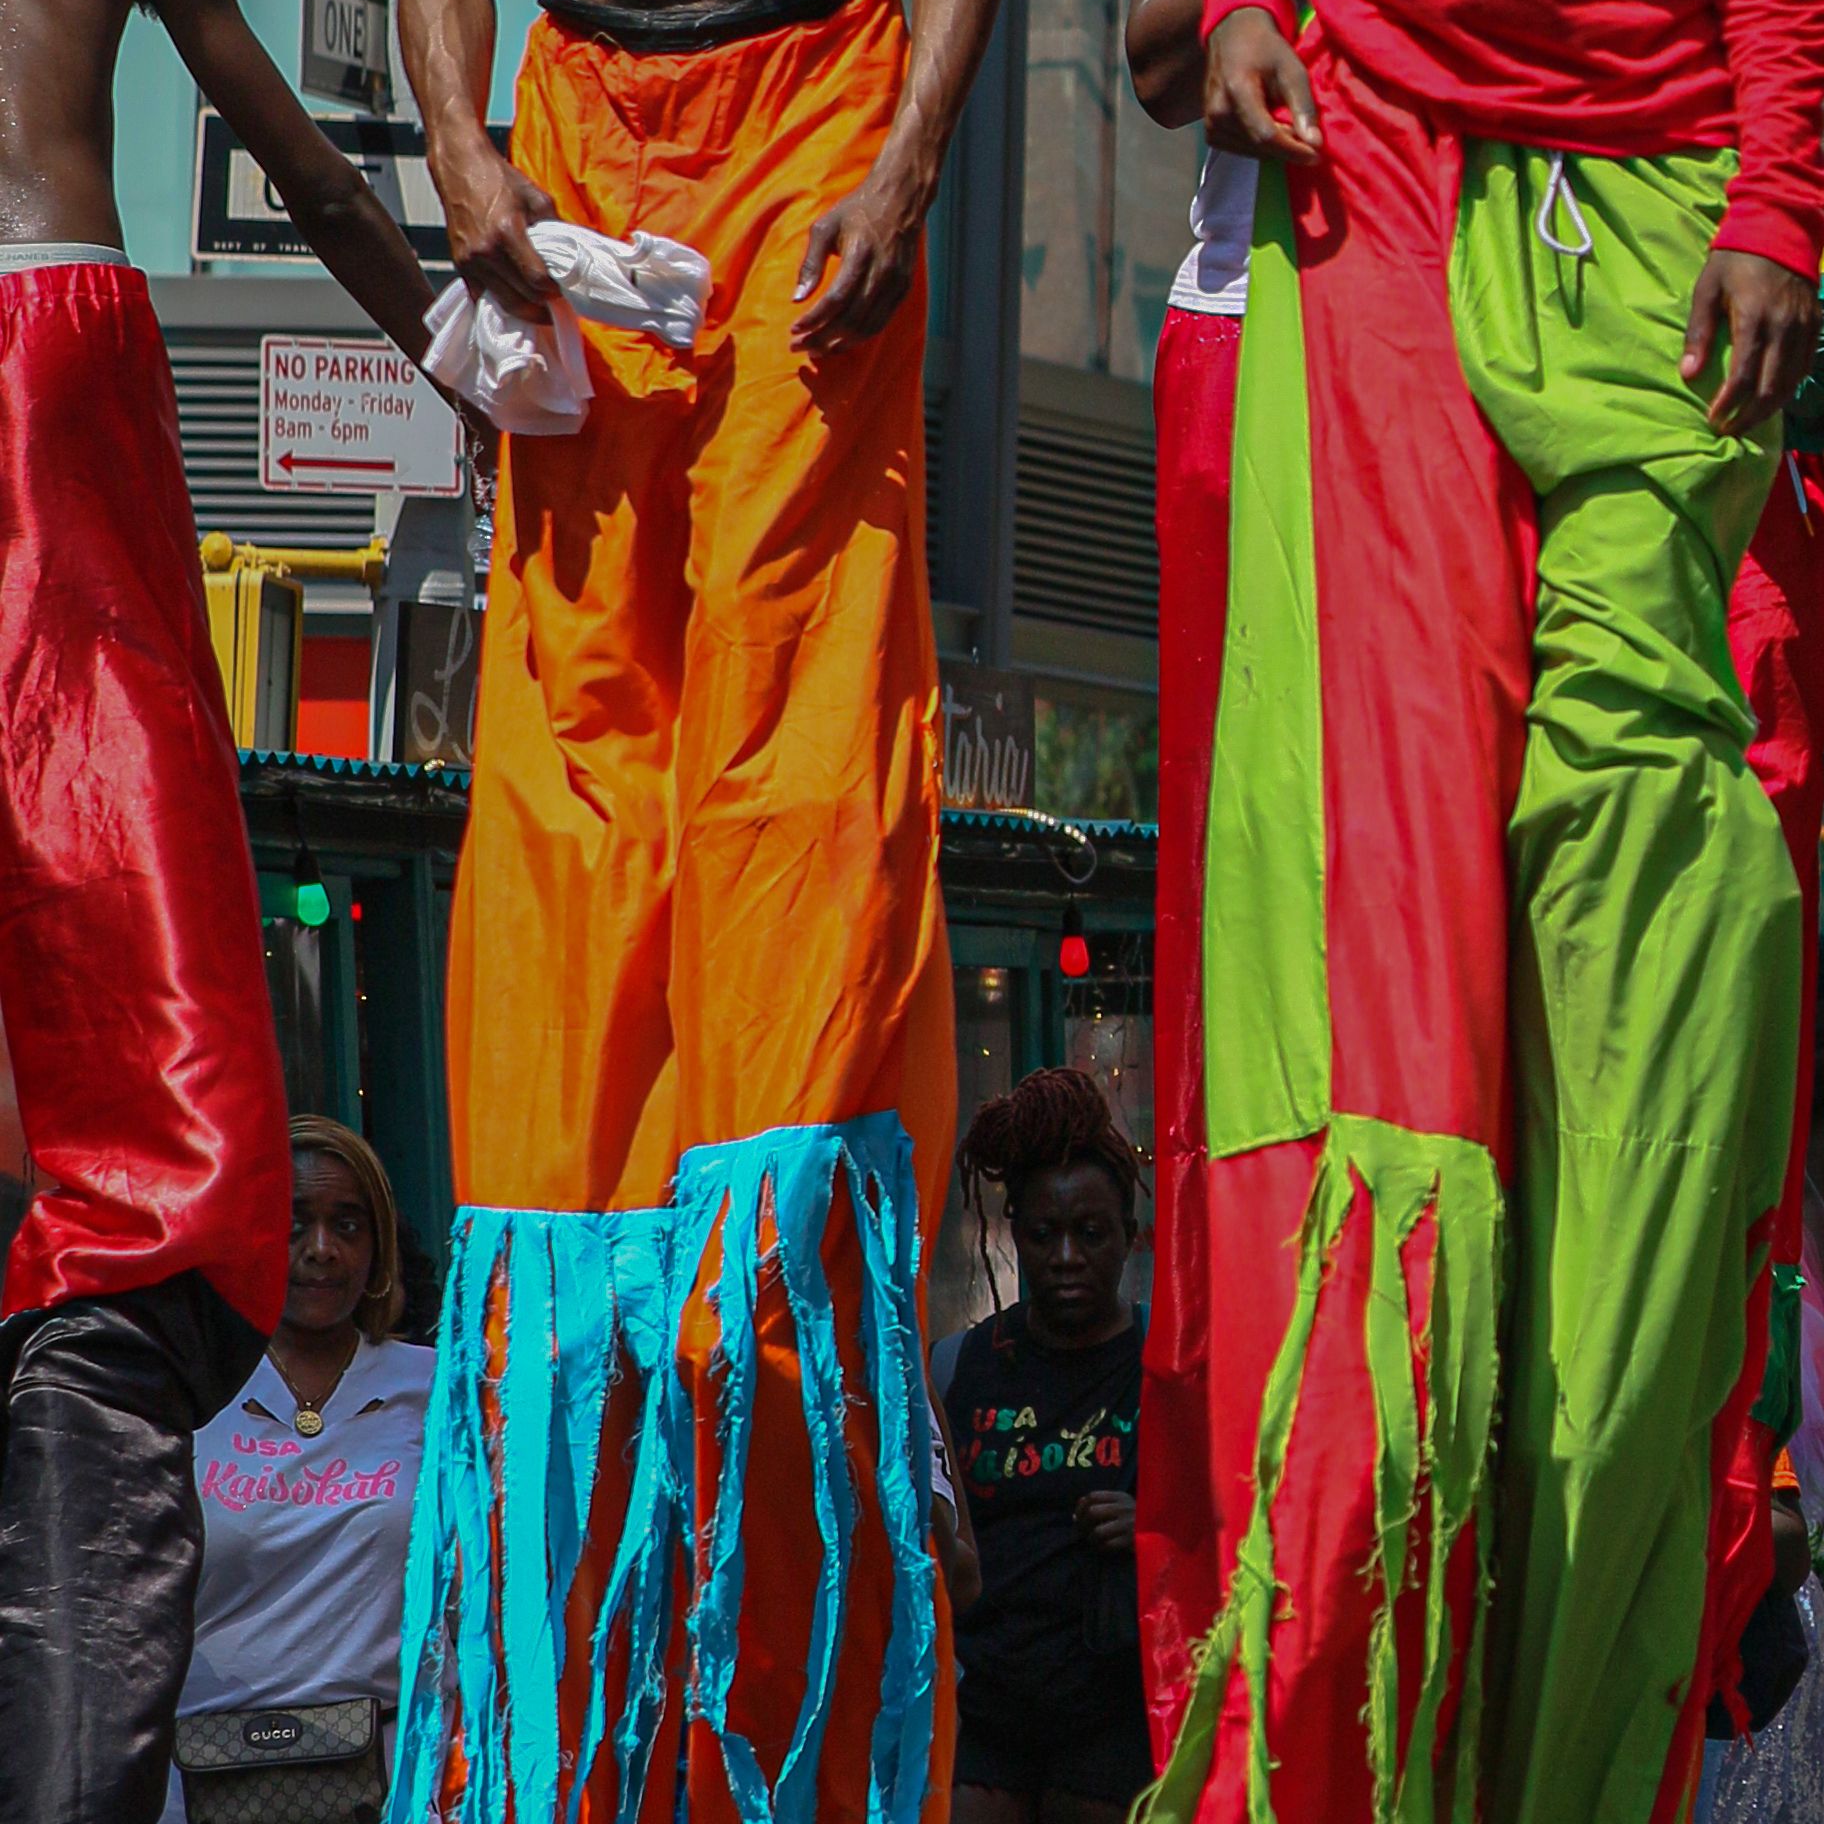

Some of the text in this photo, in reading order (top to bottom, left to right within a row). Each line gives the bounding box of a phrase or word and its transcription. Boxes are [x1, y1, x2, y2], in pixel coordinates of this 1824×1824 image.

[324, 0, 365, 59] ONE
[273, 354, 416, 386] NO PARKING
[274, 388, 343, 417] Monday
[360, 392, 415, 422] Friday
[274, 416, 313, 439] 8am
[330, 419, 370, 445] 6pm
[971, 1406, 1038, 1433] USA
[232, 1433, 302, 1457] USA
[202, 1458, 401, 1513] Kaisokah
[250, 1728, 296, 1743] GUCCI
